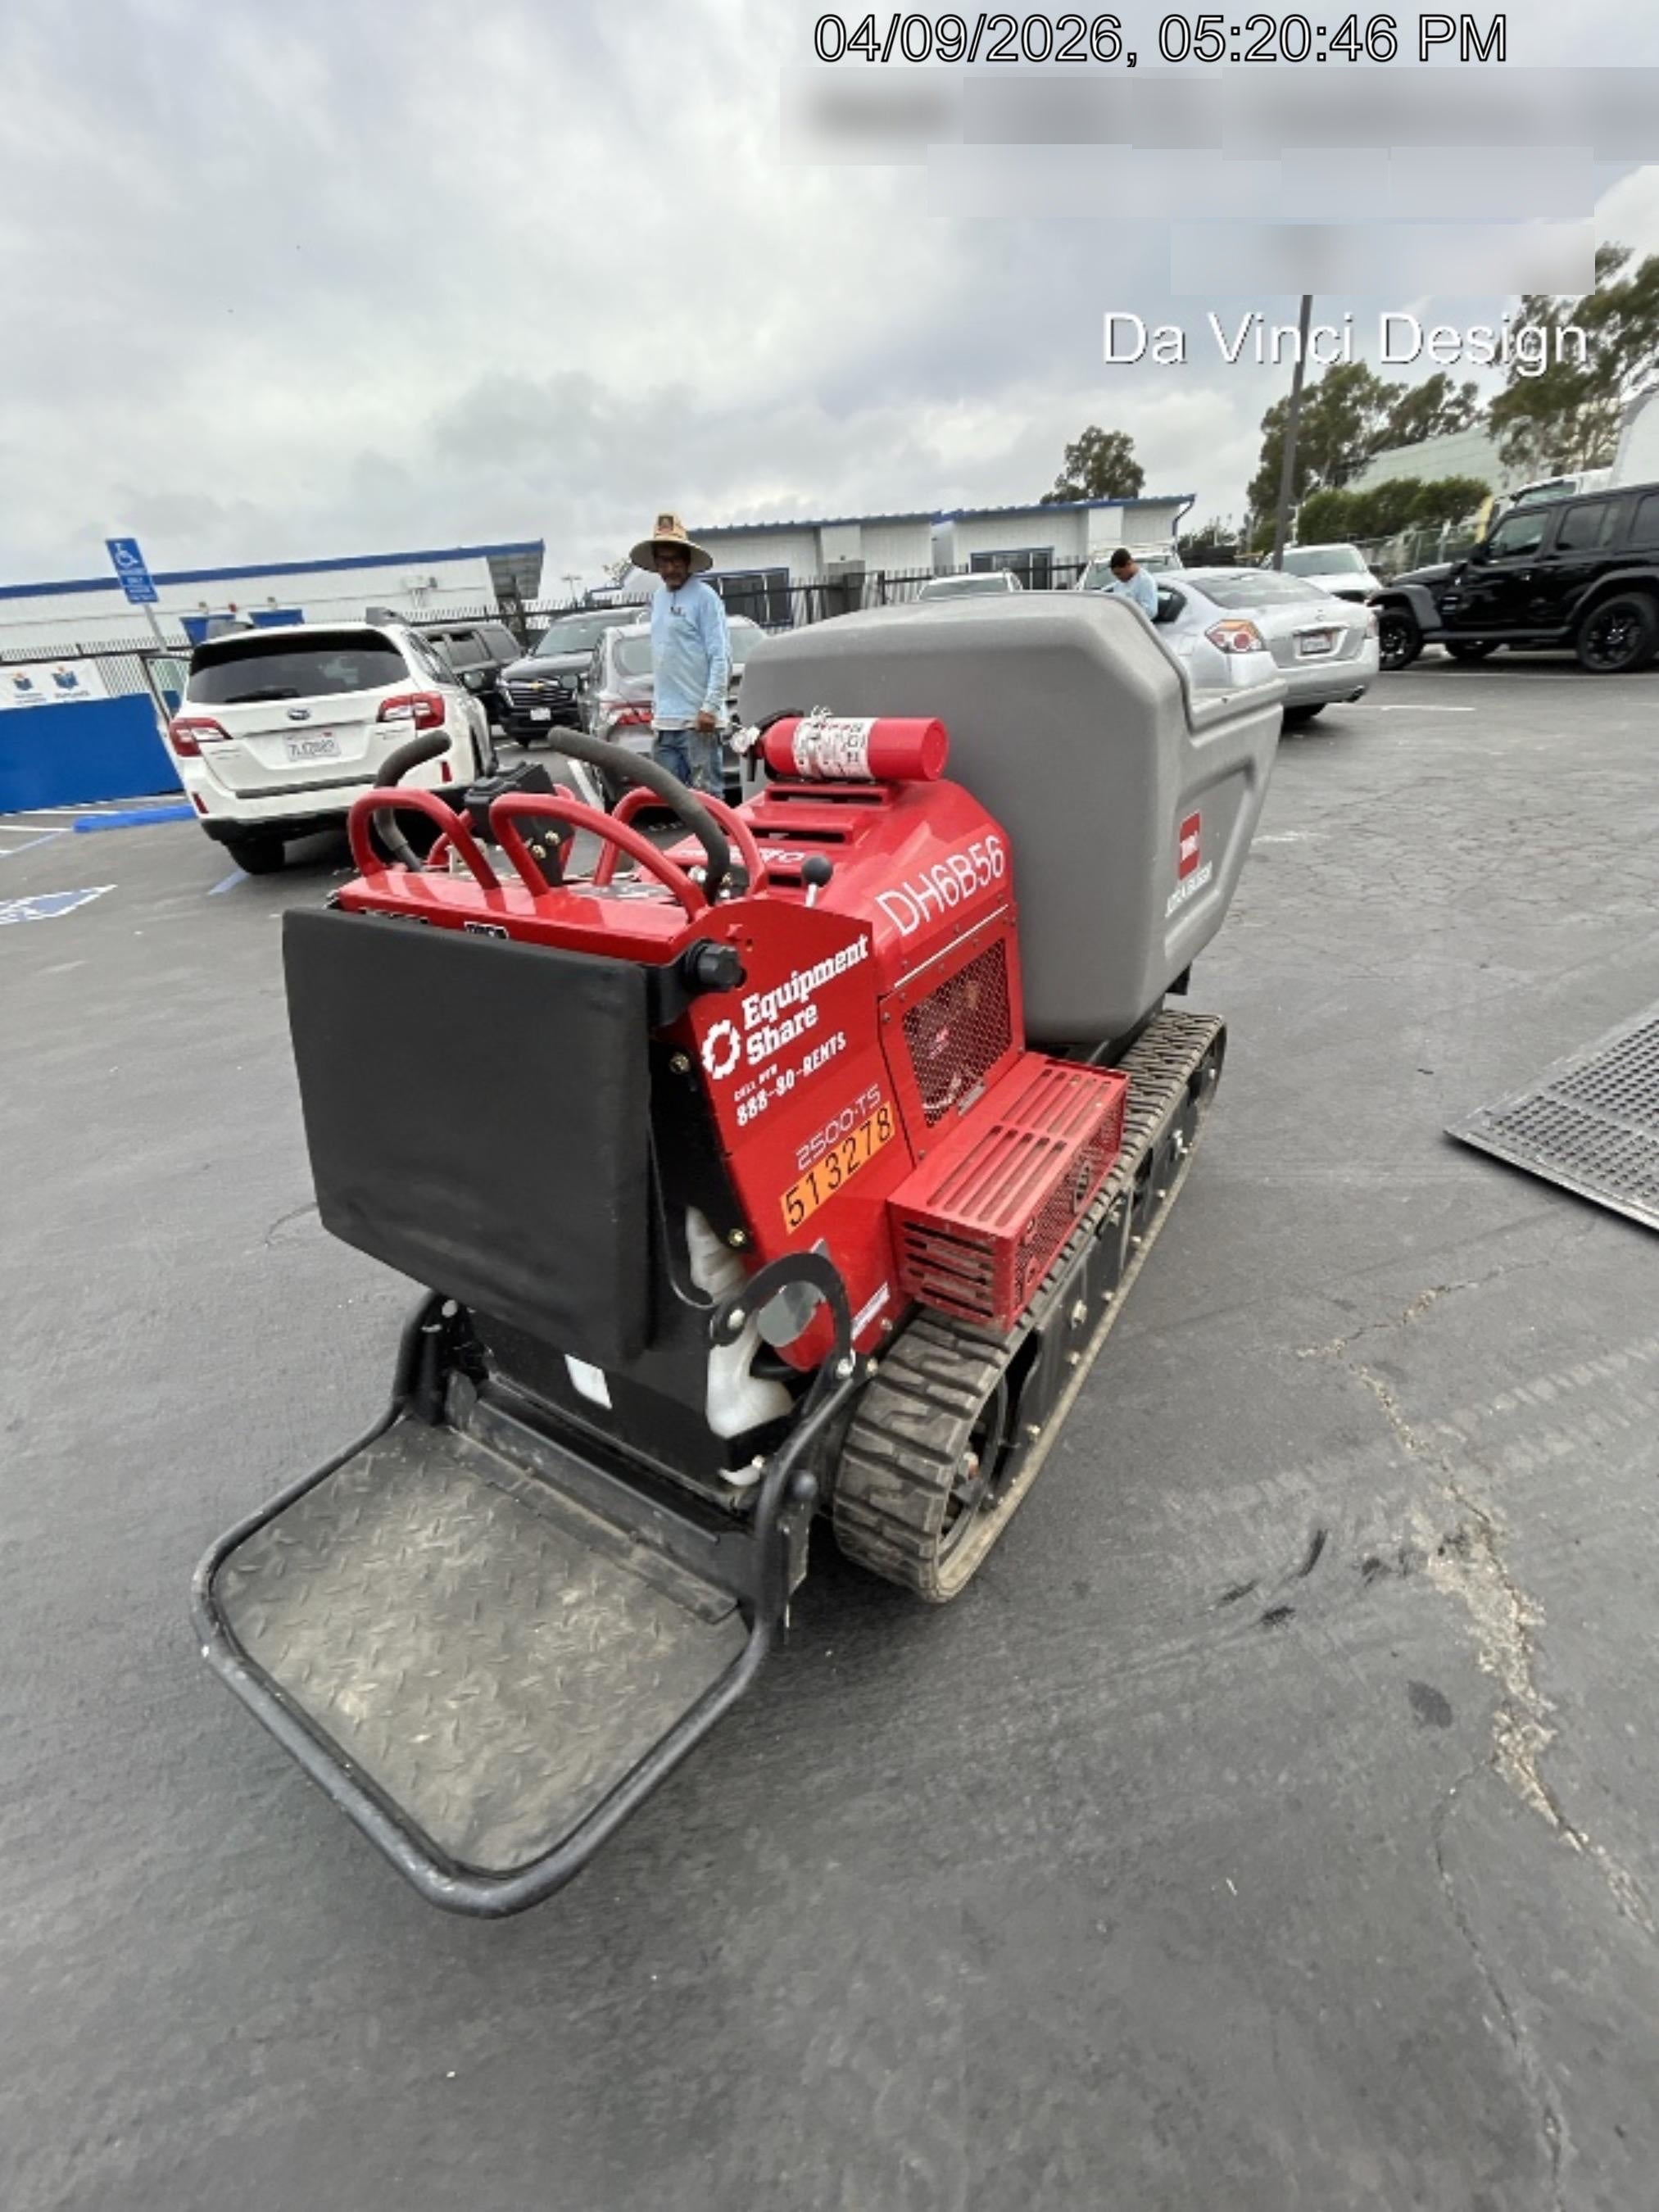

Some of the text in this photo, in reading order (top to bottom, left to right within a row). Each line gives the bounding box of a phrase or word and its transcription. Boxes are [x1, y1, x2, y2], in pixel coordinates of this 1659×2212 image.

[875, 835, 1005, 936] DH6B56
[741, 933, 868, 1031] Equipment
[746, 1004, 818, 1065] Share
[785, 1107, 891, 1227] 513278
